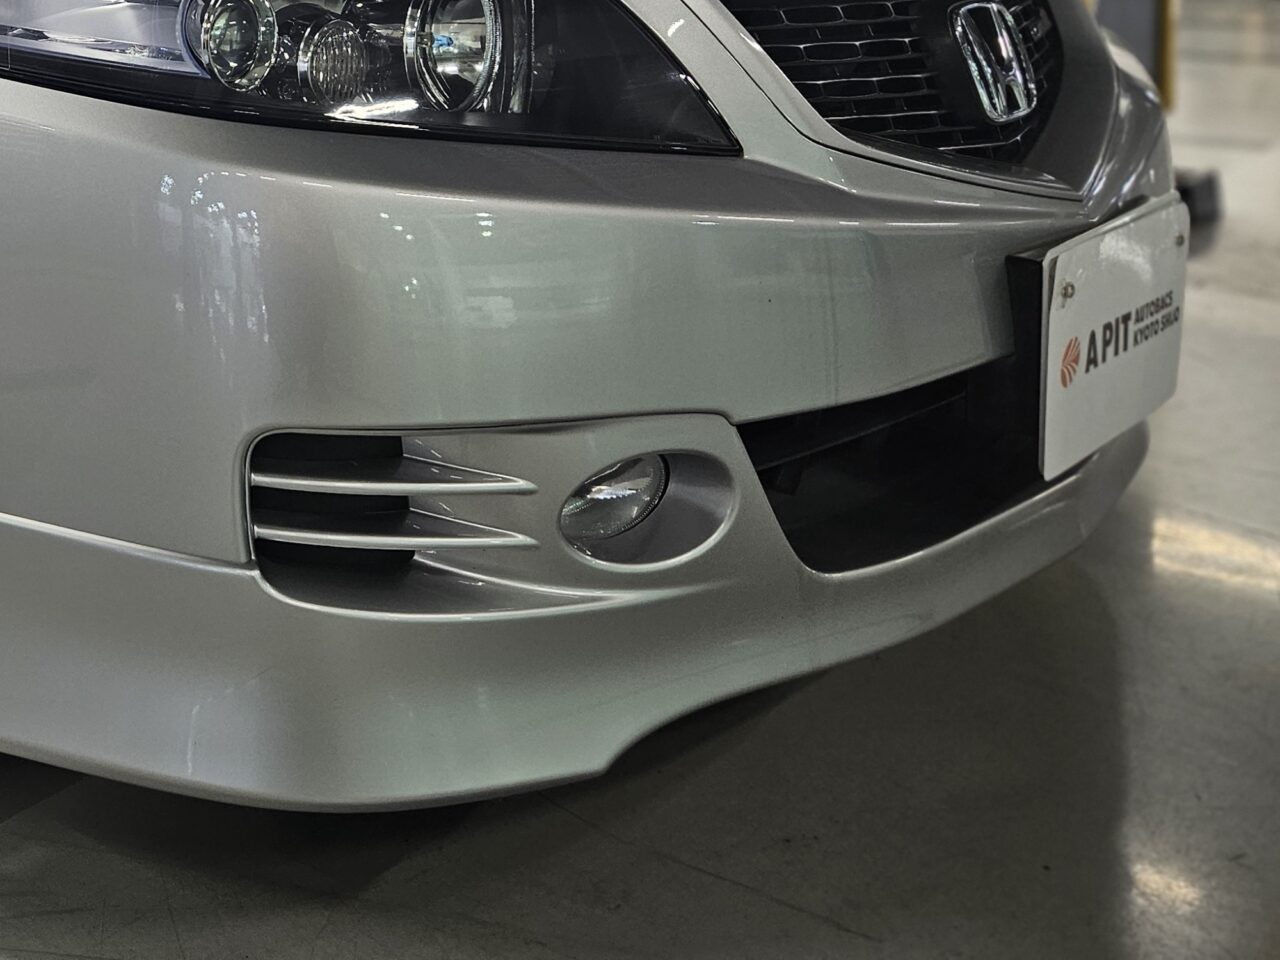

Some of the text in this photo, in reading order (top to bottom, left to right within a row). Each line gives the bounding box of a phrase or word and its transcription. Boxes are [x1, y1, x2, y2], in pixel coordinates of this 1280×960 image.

[1134, 290, 1173, 324] AUTOBACS
[1085, 311, 1131, 374] APIT
[1133, 318, 1160, 347] KYOTO
